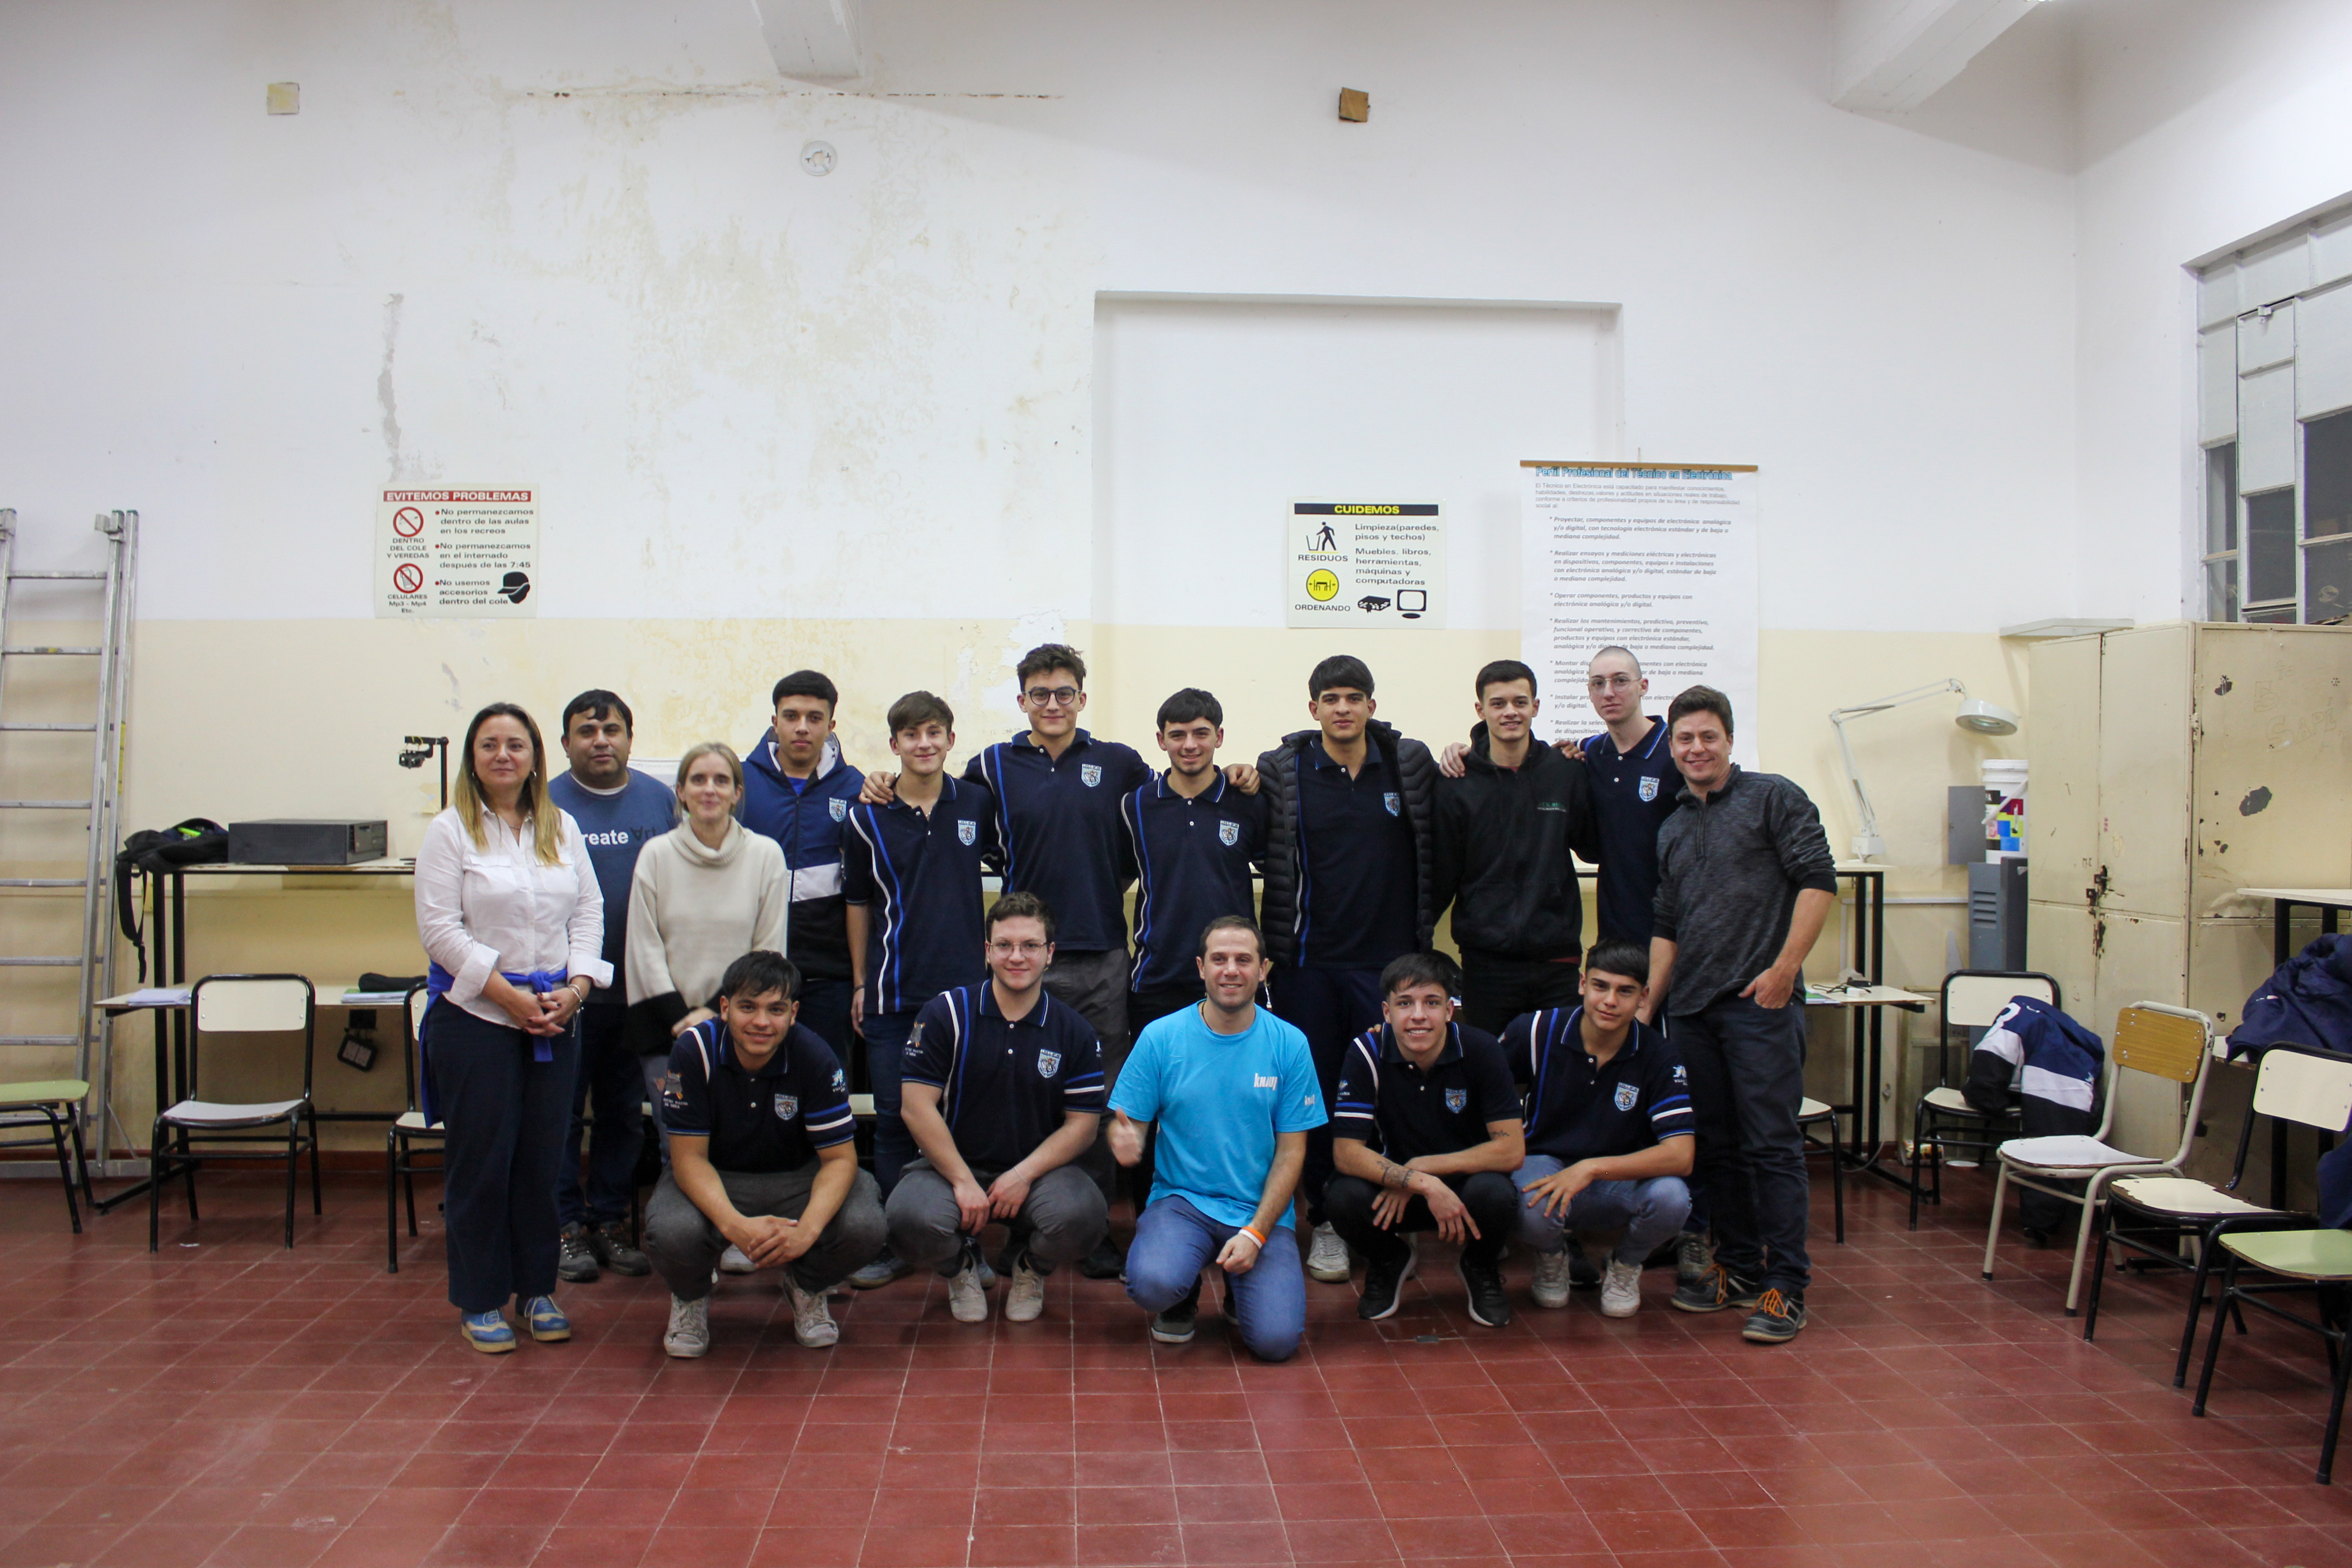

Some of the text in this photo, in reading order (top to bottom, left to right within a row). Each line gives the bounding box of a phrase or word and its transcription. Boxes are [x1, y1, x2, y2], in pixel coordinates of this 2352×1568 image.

[1536, 466, 1560, 477] Perfil
[1562, 467, 1613, 478] Profesional
[1616, 468, 1630, 478] del
[1632, 468, 1667, 479] Técnico
[1682, 469, 1732, 480] Electrónica
[387, 492, 528, 501] EVITEMOS PROBLEMAS
[1334, 505, 1400, 514] CUIDEMOS
[1356, 558, 1421, 567] herramientas,
[582, 829, 629, 846] reate
